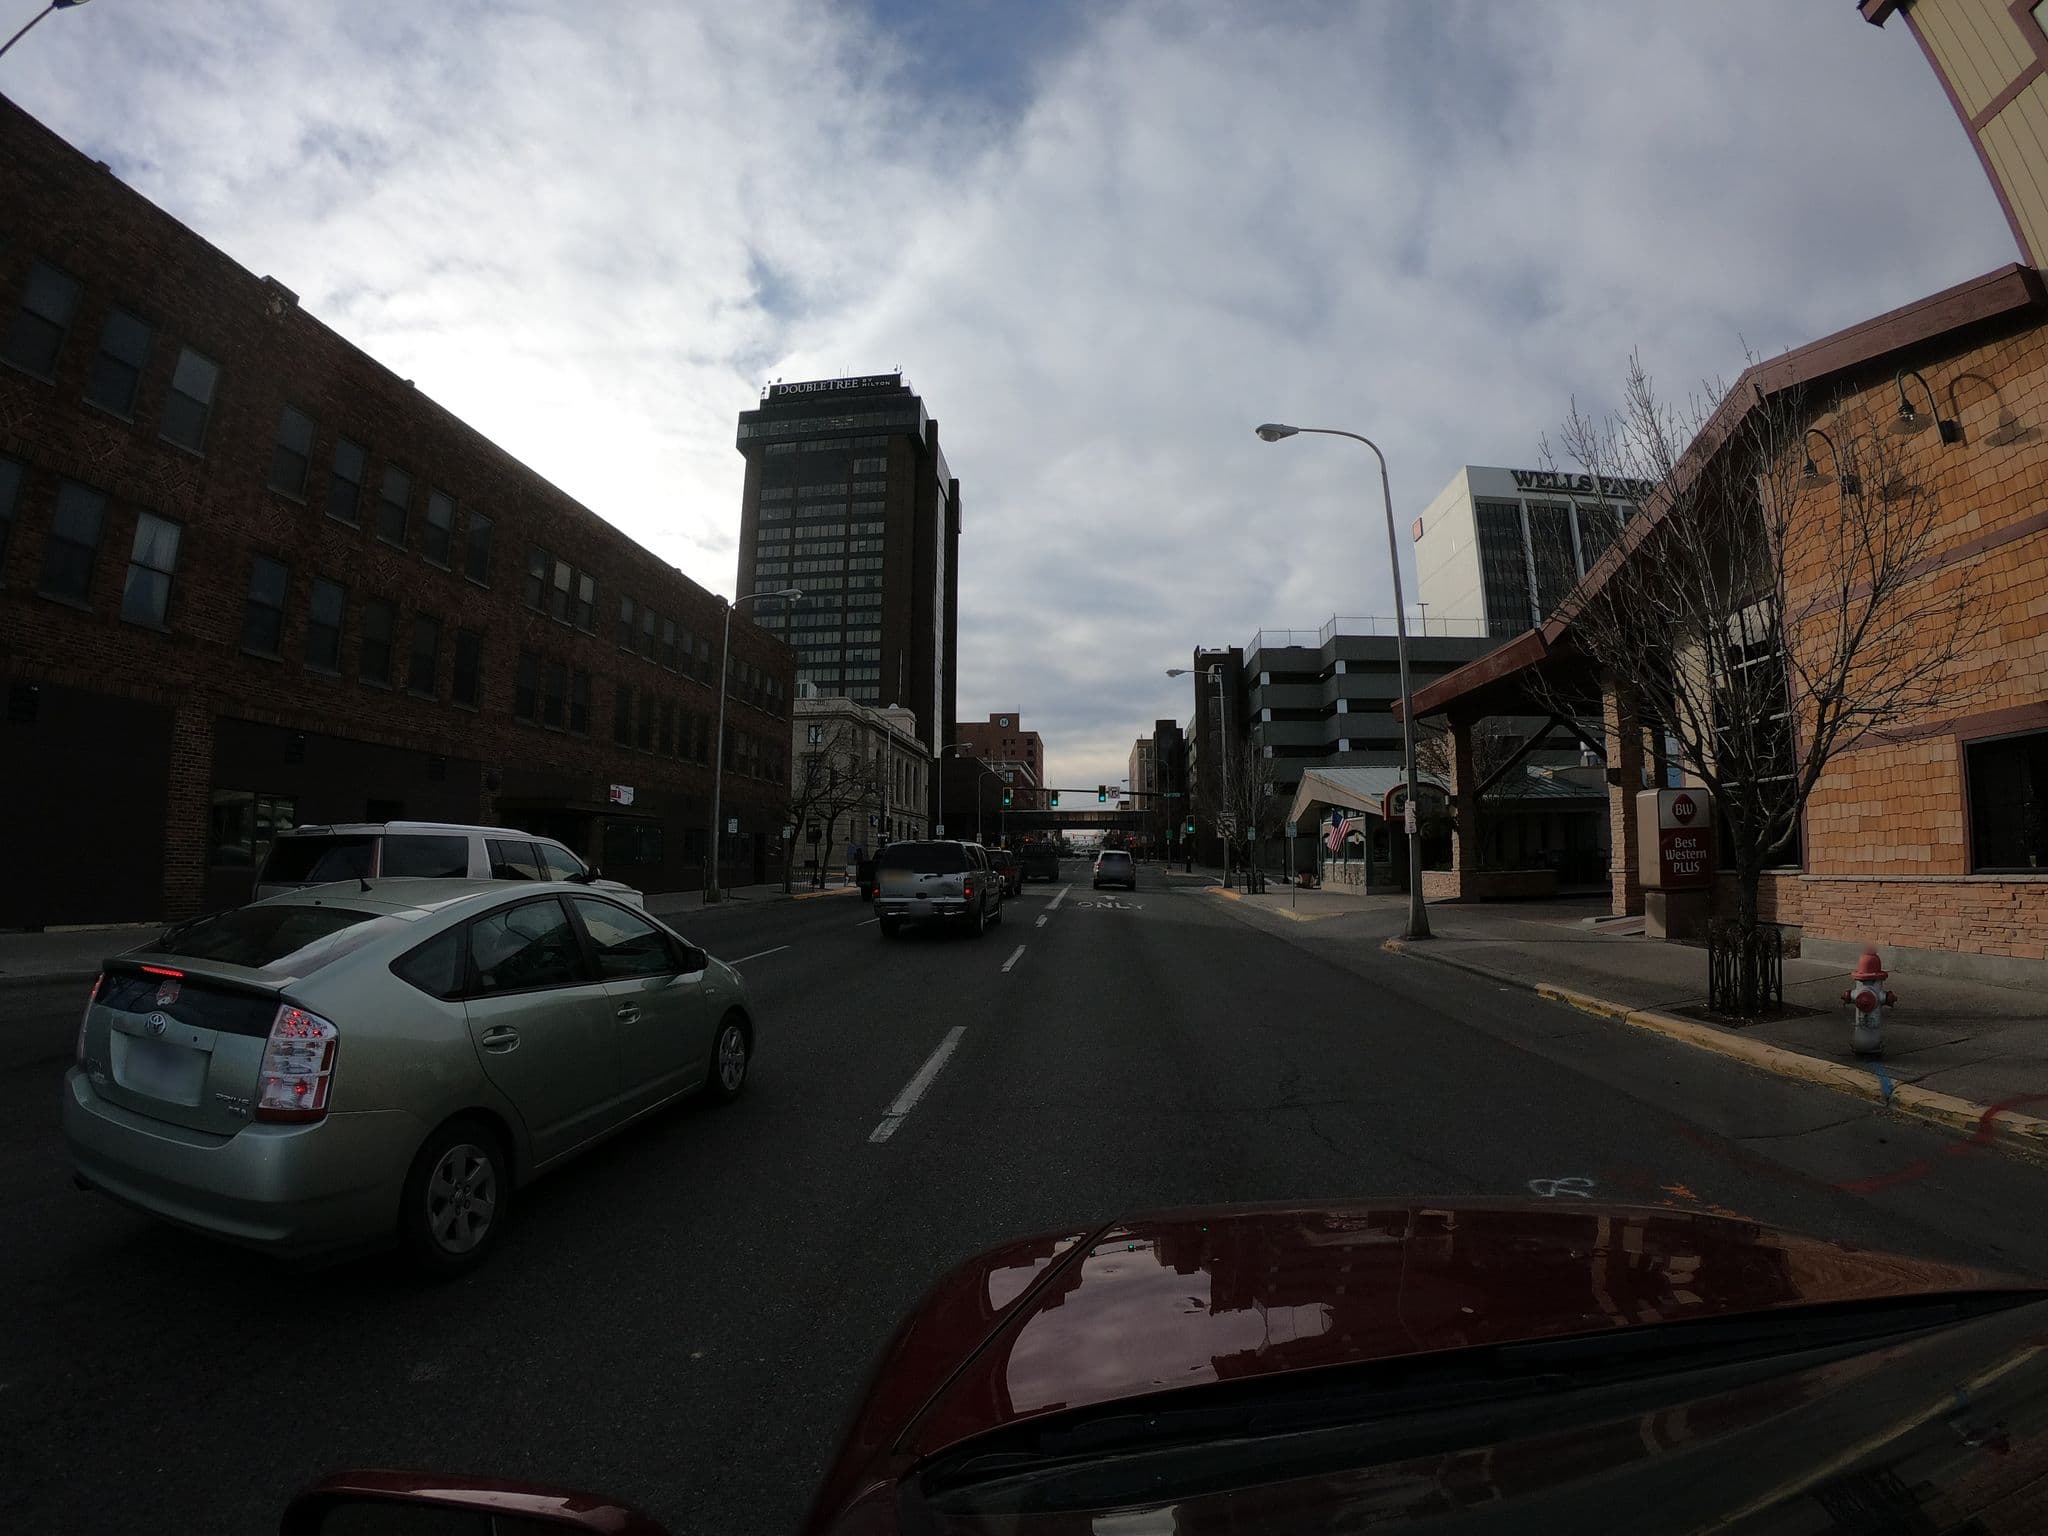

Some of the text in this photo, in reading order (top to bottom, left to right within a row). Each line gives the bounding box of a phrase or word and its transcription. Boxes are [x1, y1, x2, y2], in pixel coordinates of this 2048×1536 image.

[778, 379, 859, 395] DOUBLETREE
[1511, 471, 1593, 491] WELLS
[1675, 803, 1693, 815] BW
[1674, 837, 1697, 848] Best
[1665, 849, 1707, 861] Western
[1673, 861, 1700, 873] PLUS
[1077, 901, 1144, 910] ONLY
